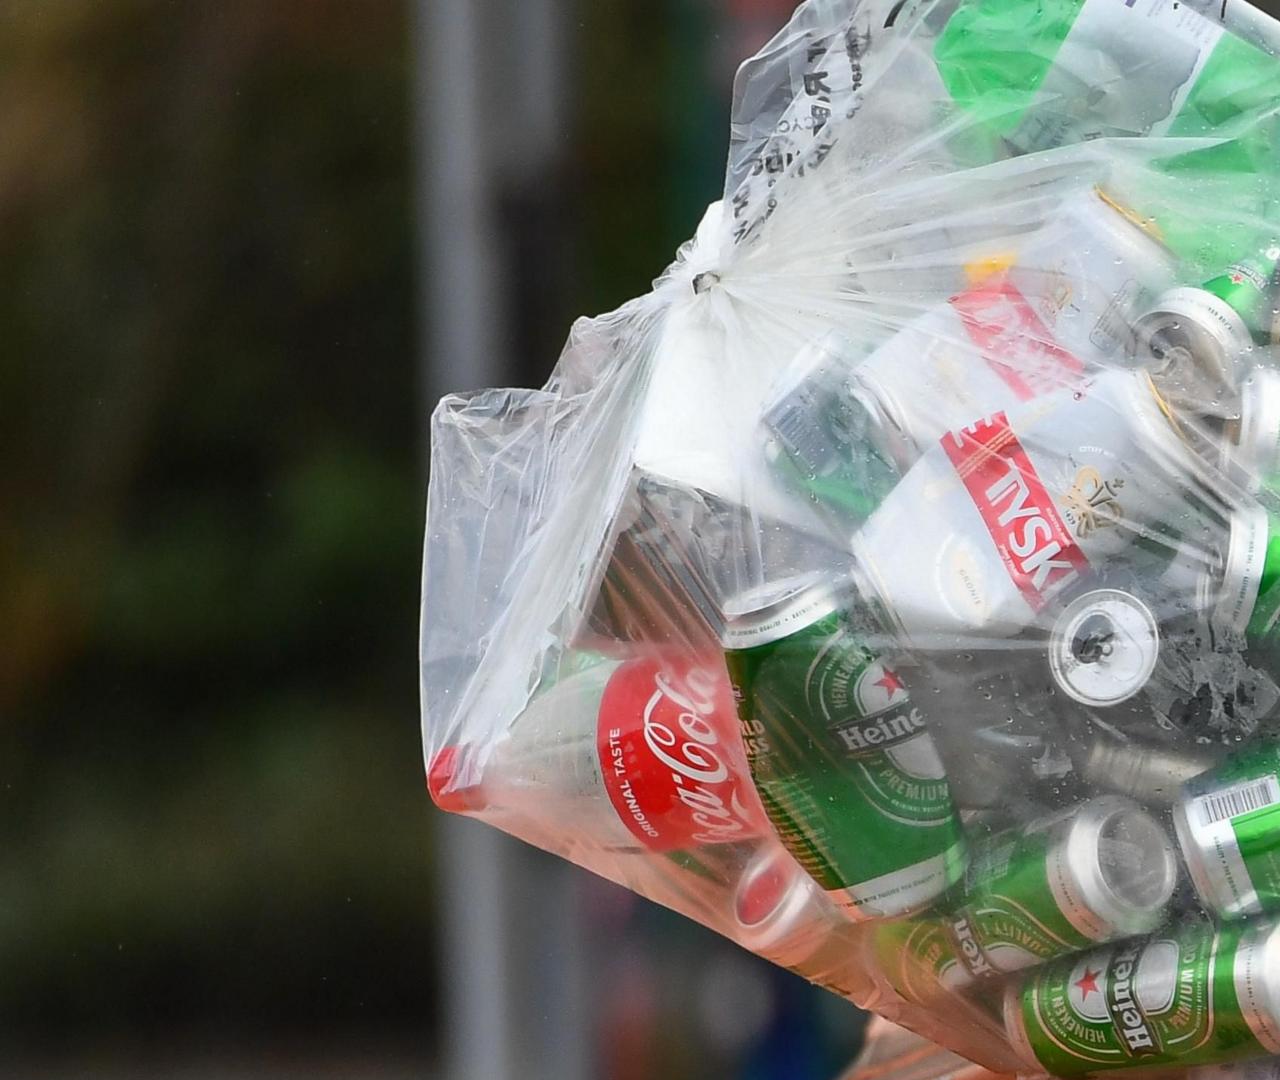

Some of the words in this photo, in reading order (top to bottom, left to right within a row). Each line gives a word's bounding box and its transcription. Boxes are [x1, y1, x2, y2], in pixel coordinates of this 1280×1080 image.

[985, 457, 1080, 601] TYSKI
[609, 727, 627, 777] TASTE
[837, 706, 927, 751] Heine
[620, 780, 660, 838] ORIGINAL
[1051, 996, 1107, 1044] HEINEKEN
[1112, 944, 1154, 1051] Heinek
